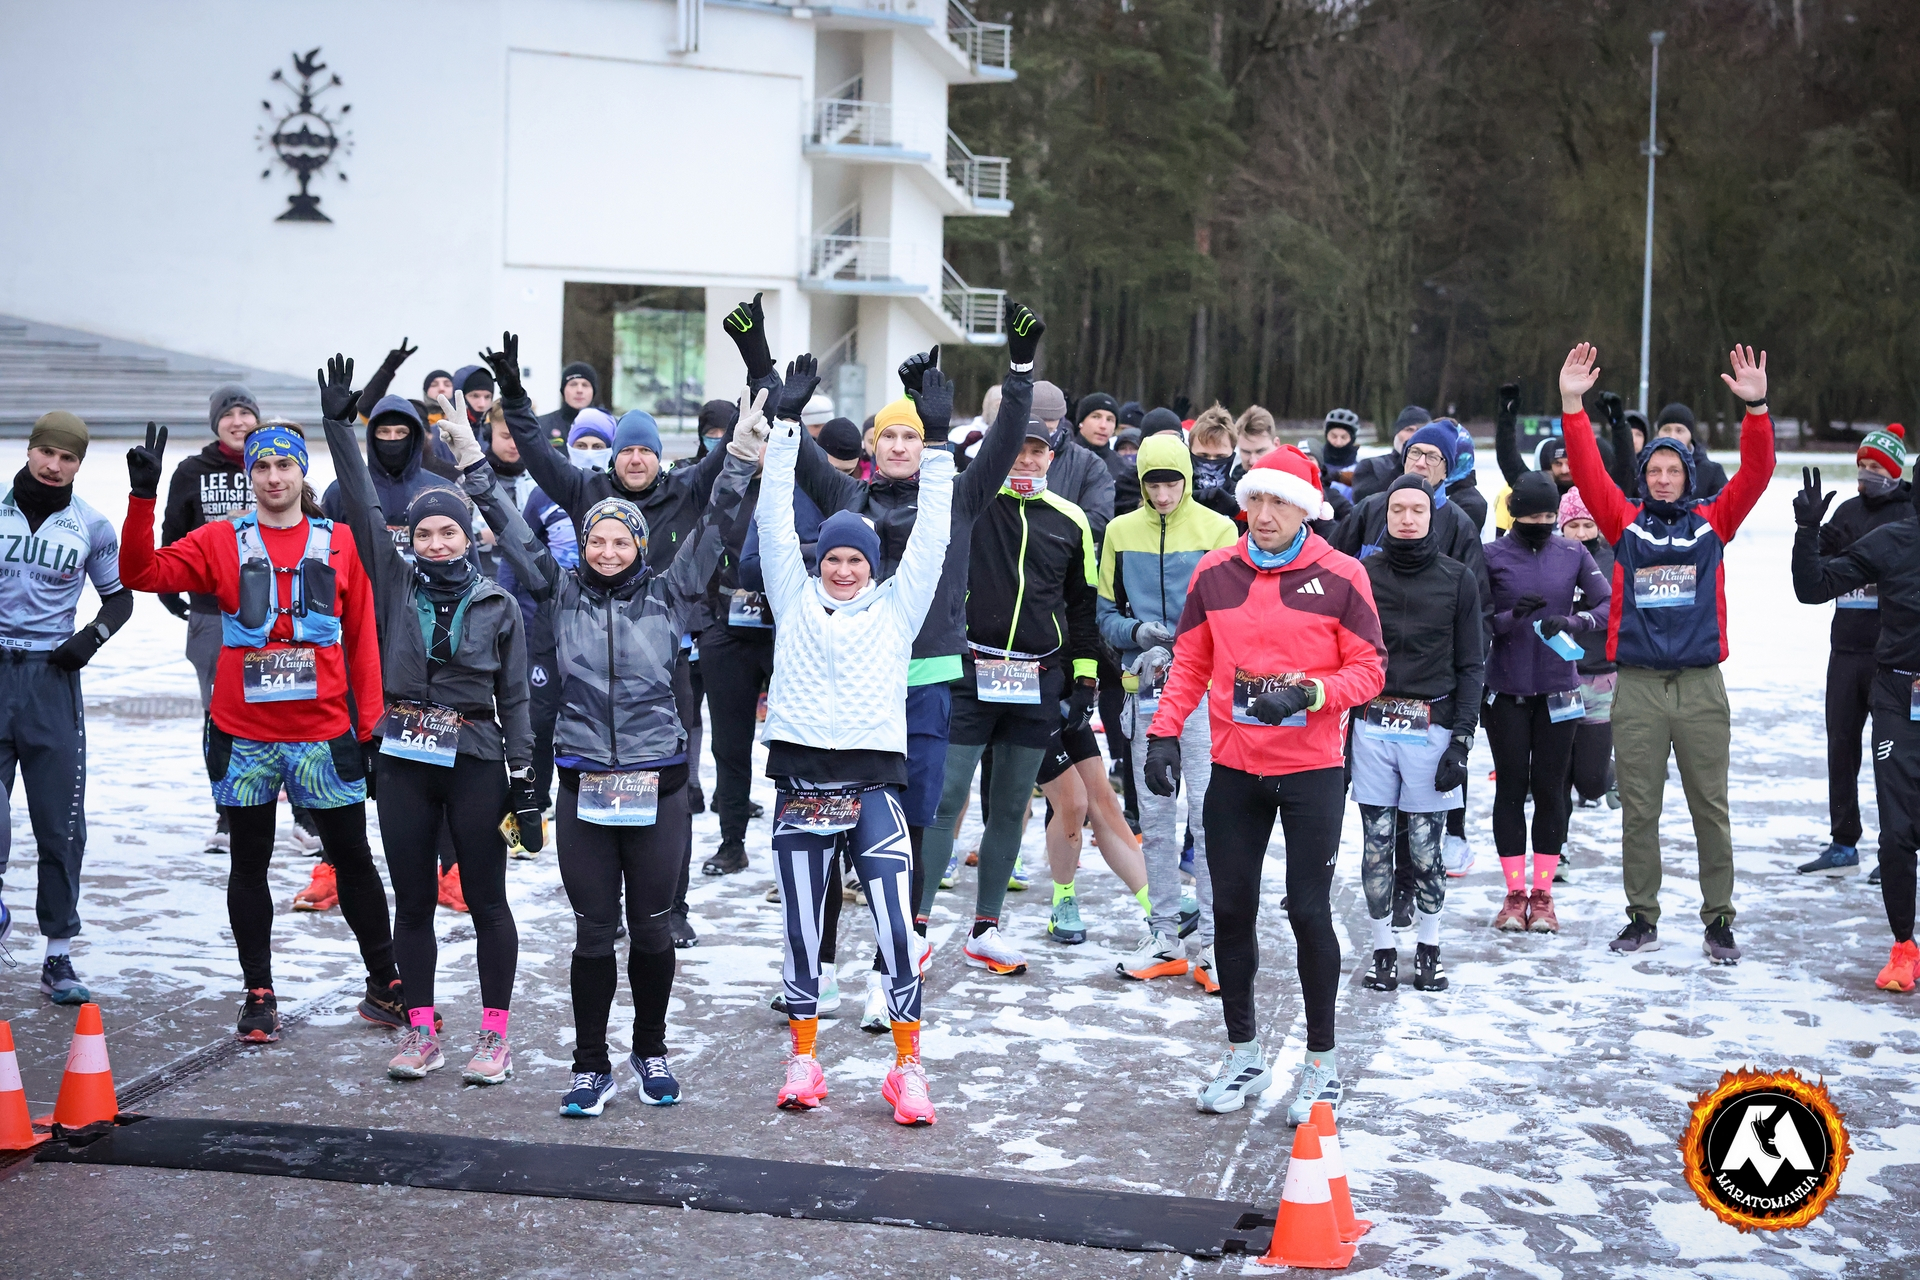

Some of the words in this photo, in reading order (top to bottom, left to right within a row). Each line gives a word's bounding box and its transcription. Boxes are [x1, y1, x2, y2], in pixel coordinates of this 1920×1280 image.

[200, 472, 228, 491] LEE
[1013, 482, 1029, 490] TG
[200, 489, 244, 502] BRITISH
[201, 502, 244, 514] HERITAGE
[1648, 584, 1680, 599] 209
[266, 653, 314, 672] Naujus
[260, 672, 296, 692] 541
[998, 664, 1037, 682] Naujus
[991, 680, 1023, 695] 212
[1390, 700, 1428, 720] Naujus
[413, 710, 458, 736] Naujus
[1380, 716, 1412, 734] 542
[400, 729, 438, 753] 546
[606, 773, 656, 797] Naujus
[610, 796, 620, 815] 1
[805, 817, 830, 830] 33
